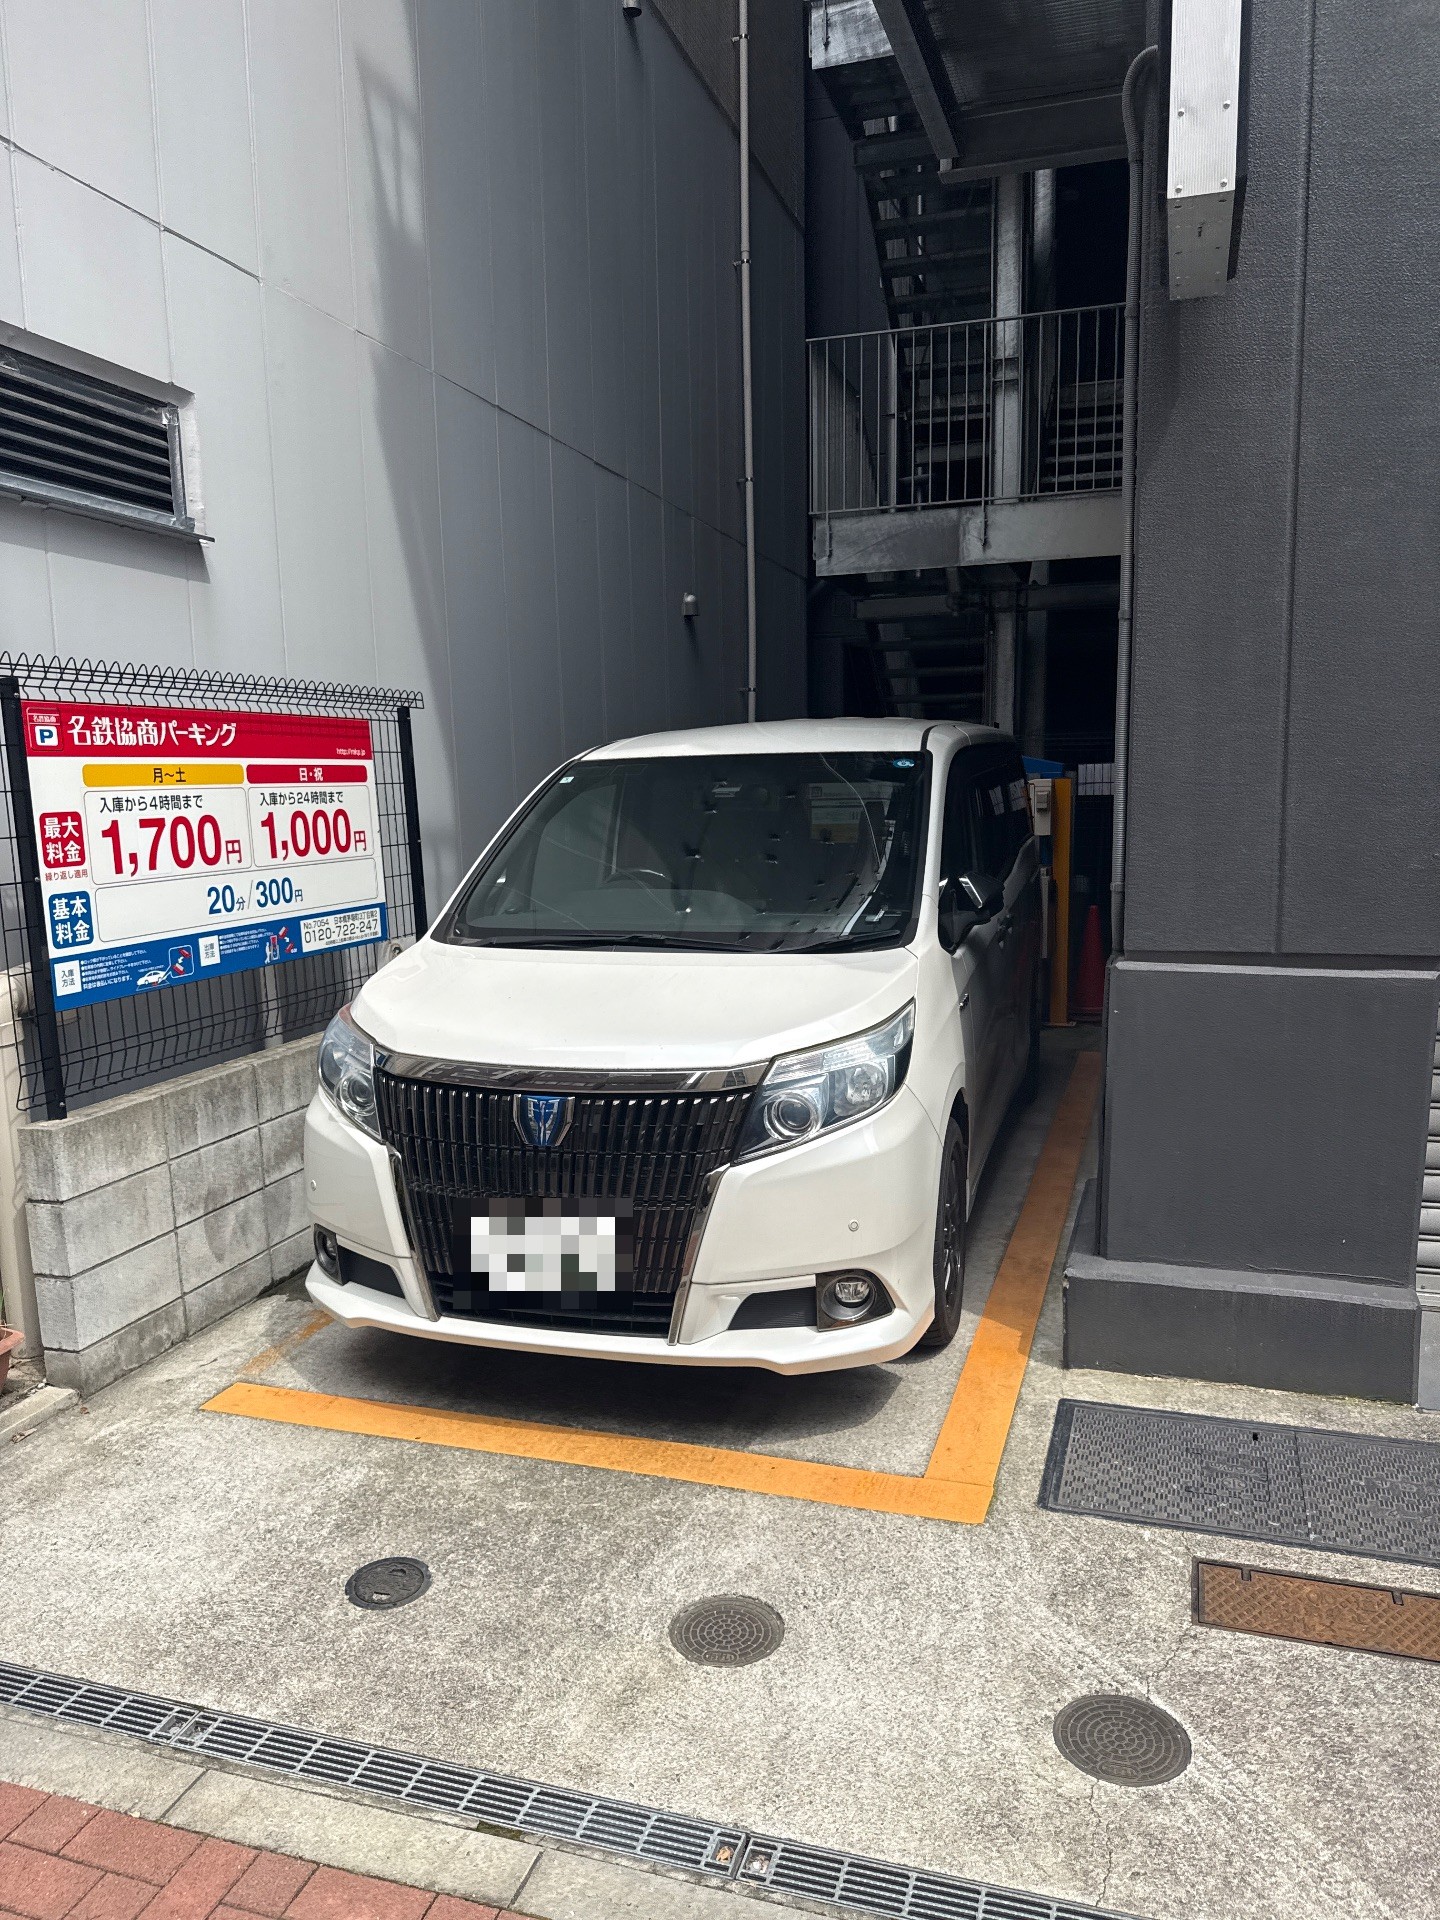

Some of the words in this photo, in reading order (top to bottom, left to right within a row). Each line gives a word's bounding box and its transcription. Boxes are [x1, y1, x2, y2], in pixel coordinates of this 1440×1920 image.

[39, 729, 53, 743] P
[67, 715, 237, 747] 名鉄協商パーキング
[100, 794, 203, 814] 入庫から4時間まで
[260, 791, 343, 806] 入庫から24時間まで
[44, 815, 80, 840] 最大
[260, 808, 367, 861] 1,000円
[46, 840, 82, 864] 料金
[101, 814, 243, 877] 1,700円
[45, 868, 88, 881] 繰り返し適用
[53, 895, 88, 921] 基本
[56, 919, 90, 945] 料金
[304, 919, 378, 943] 0120-722-247
[61, 968, 75, 979] 入庫
[62, 977, 76, 987] 方法
